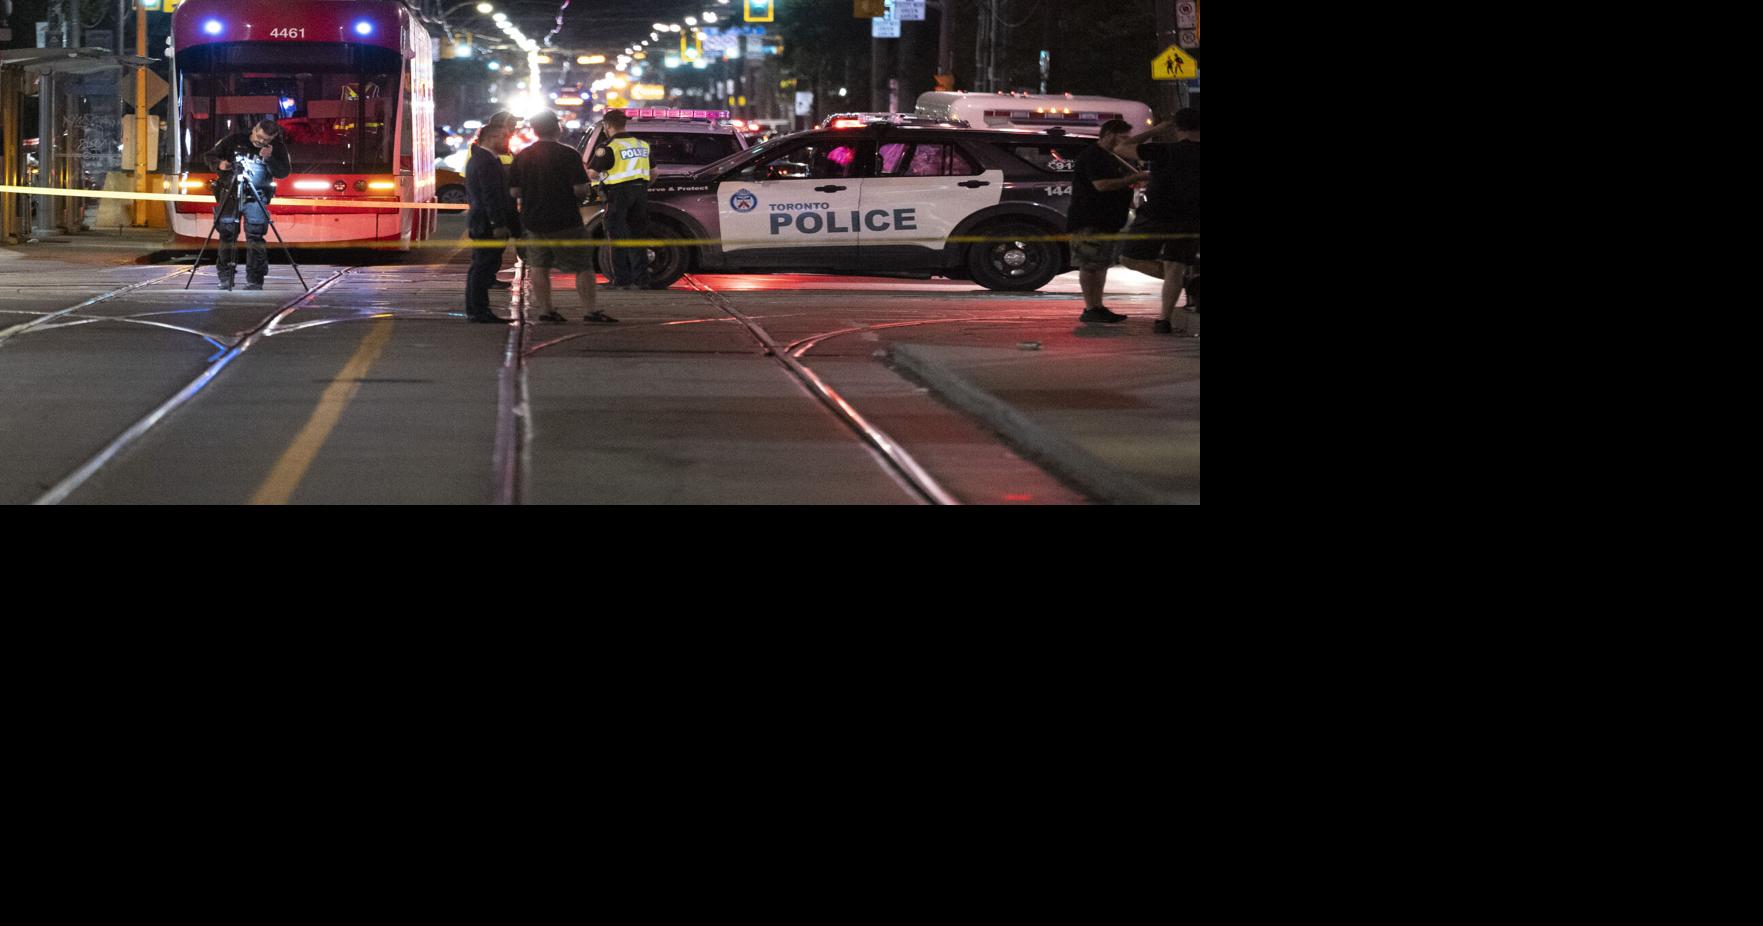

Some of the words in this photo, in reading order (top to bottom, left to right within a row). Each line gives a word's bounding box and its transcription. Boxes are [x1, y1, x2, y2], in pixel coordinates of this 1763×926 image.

[270, 28, 304, 38] 4461
[769, 203, 829, 211] TORONTO
[770, 208, 917, 234] POLICE
